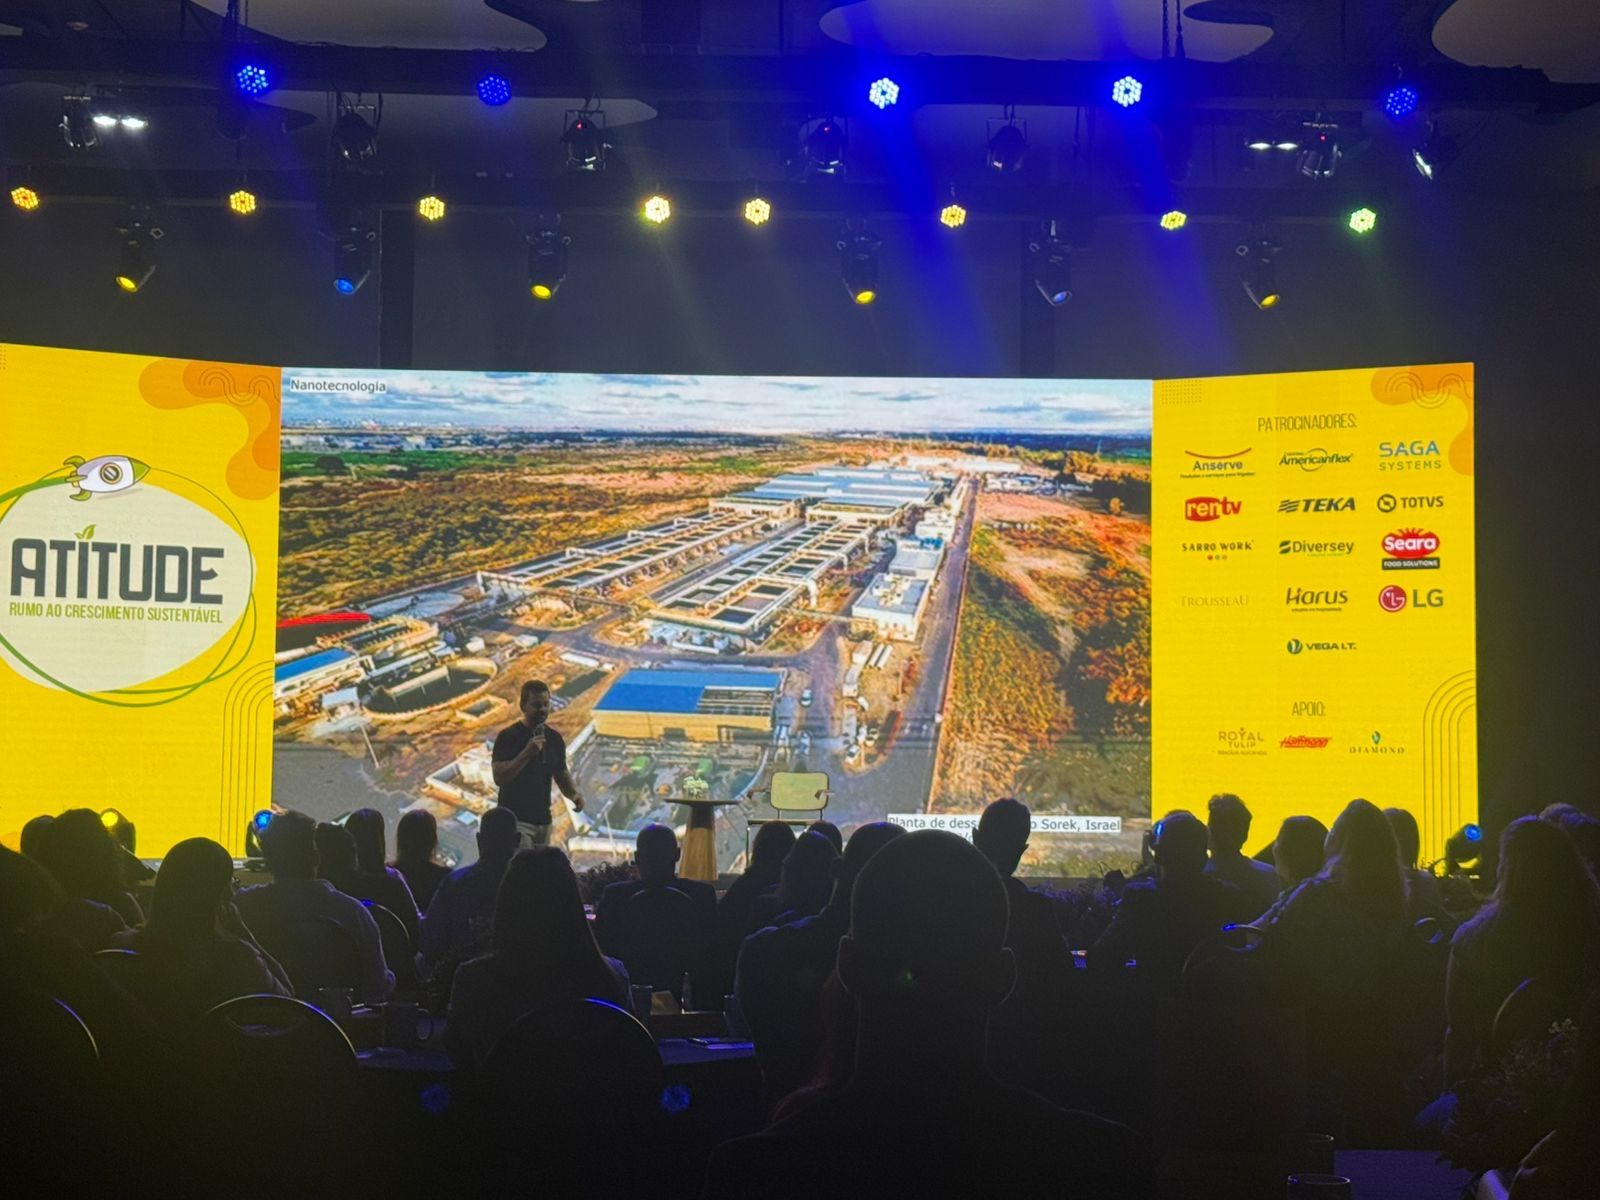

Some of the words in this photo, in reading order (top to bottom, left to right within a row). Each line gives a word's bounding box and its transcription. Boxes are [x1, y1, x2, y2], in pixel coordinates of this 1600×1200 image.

[291, 380, 386, 394] Nanotecnologia
[1258, 413, 1357, 432] PATROCINADORES:
[1379, 440, 1440, 457] SAGA
[1192, 460, 1243, 471] Anserve
[1279, 453, 1352, 466] Americanflex
[1379, 460, 1441, 471] SYSTEMS
[1302, 497, 1356, 512] TEKA
[1400, 496, 1444, 508] TOTVS
[1182, 542, 1216, 551] SARRO
[1220, 541, 1252, 551] WORK
[1293, 540, 1354, 555] Diversey
[1384, 536, 1437, 551] Seara
[1403, 559, 1438, 567] SOLUTIONS
[10, 537, 225, 605] ATITUDE
[1286, 587, 1349, 605] Harus
[1413, 588, 1444, 608] LG
[9, 602, 43, 617] RUMO
[46, 603, 62, 618] AO
[65, 604, 145, 621] CRESCIMENTO
[147, 606, 223, 624] SUSTENTÁVEL
[1306, 642, 1339, 650] VEGA
[1218, 731, 1264, 742] ROYAL
[1228, 741, 1256, 749] TULIP
[1349, 746, 1405, 754] DIAMOND
[930, 817, 945, 828] de
[1041, 818, 1081, 832] Sorek,
[1086, 819, 1120, 831] Israel
